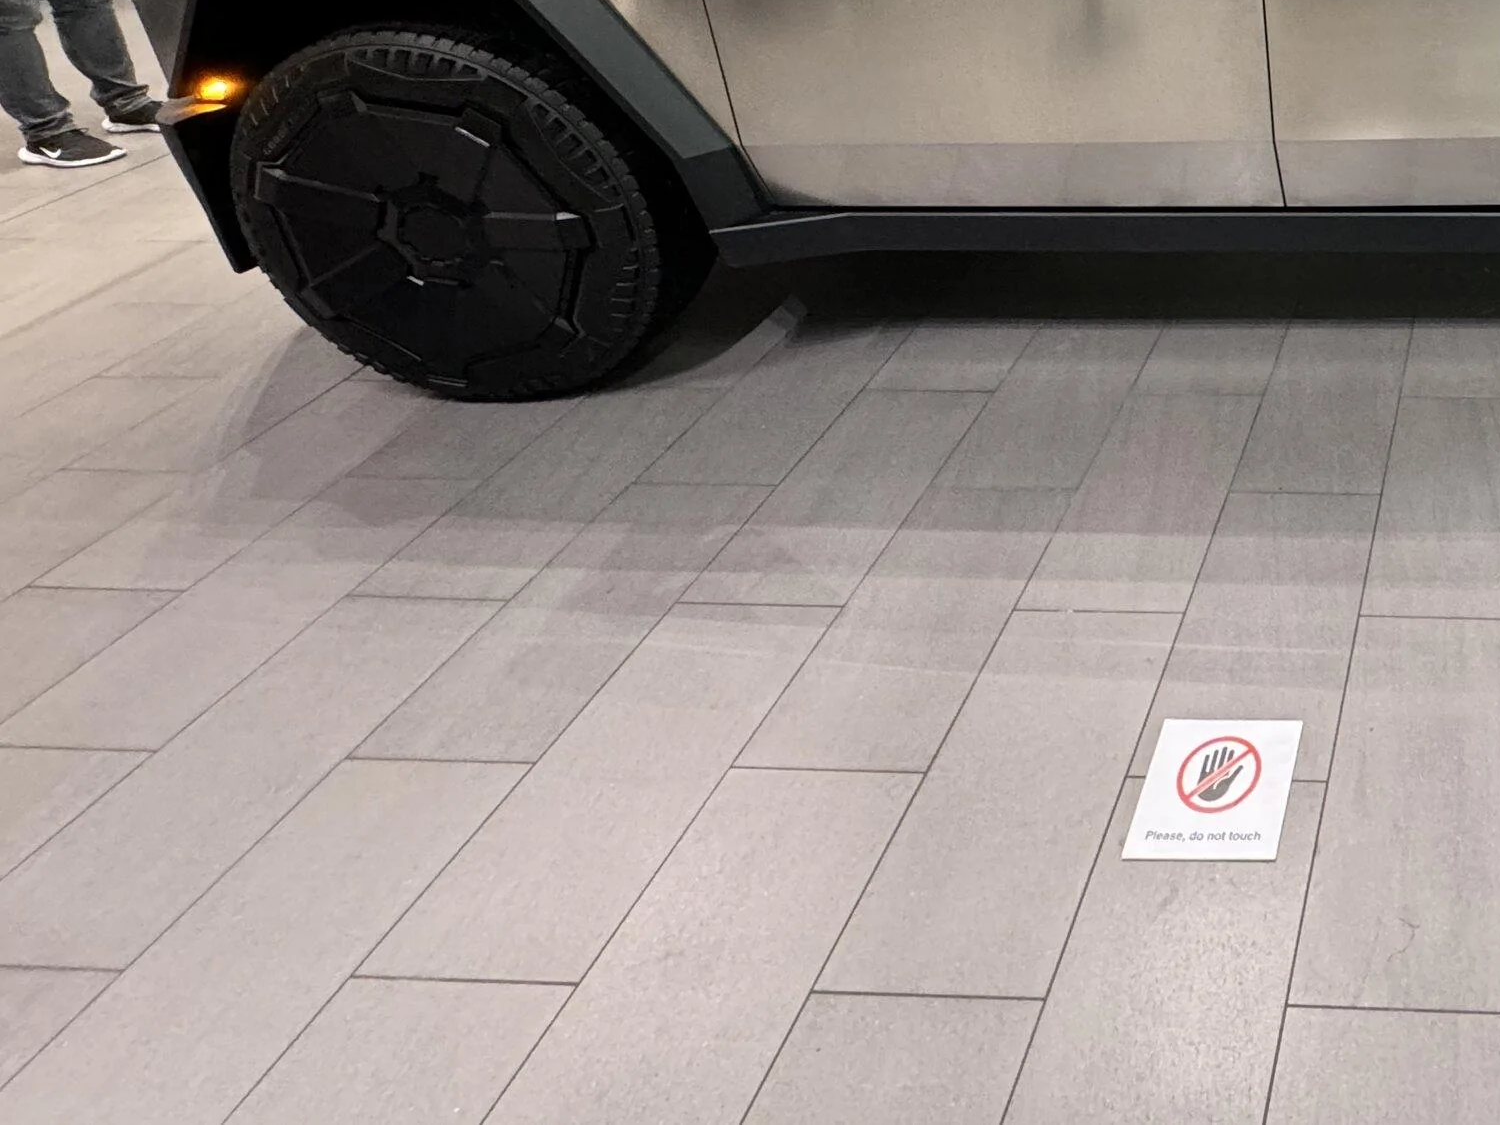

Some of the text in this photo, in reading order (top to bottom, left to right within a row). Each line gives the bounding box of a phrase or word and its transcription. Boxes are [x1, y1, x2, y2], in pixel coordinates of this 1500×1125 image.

[1144, 830, 1261, 842] Please, do not touch
